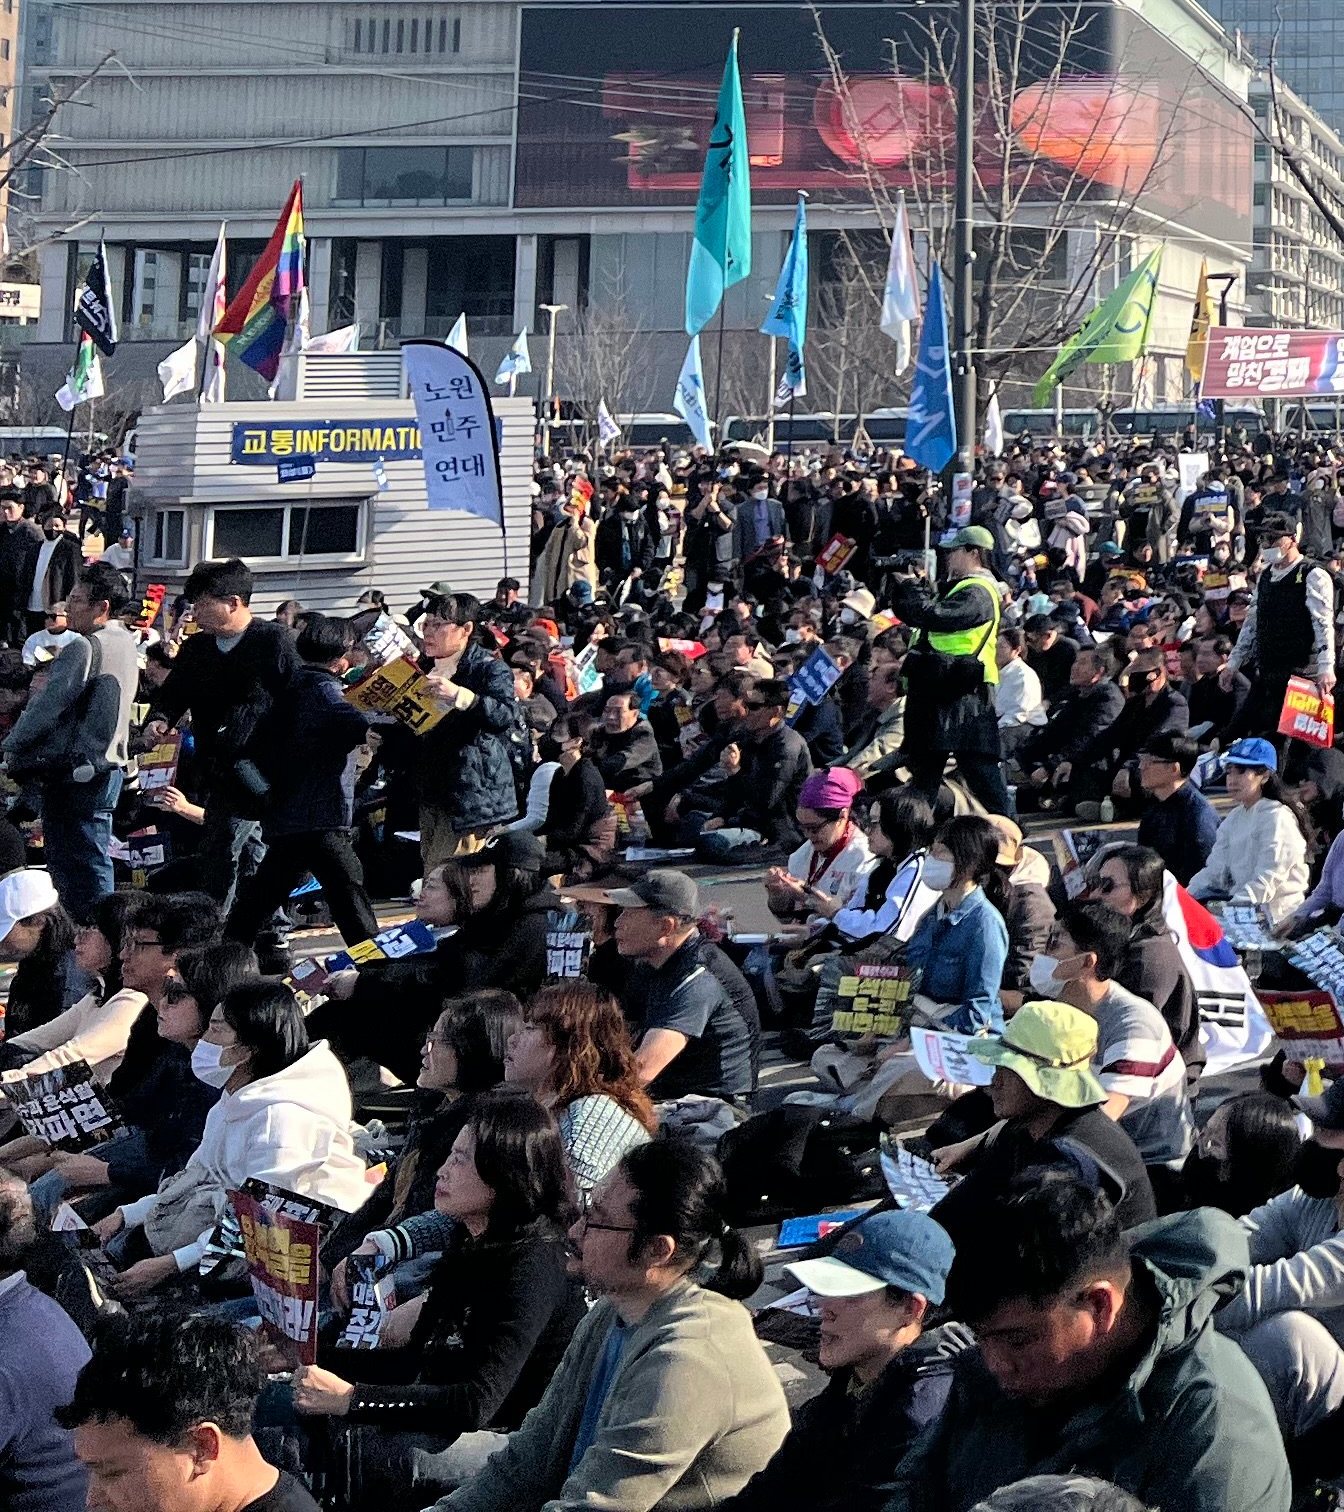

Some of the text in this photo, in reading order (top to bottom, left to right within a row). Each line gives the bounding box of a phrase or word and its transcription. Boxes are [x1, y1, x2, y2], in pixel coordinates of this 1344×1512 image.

[1220, 333, 1290, 360] 계엄으로
[424, 374, 475, 400] 노원
[429, 407, 480, 443] 민주
[434, 450, 484, 483] 연대
